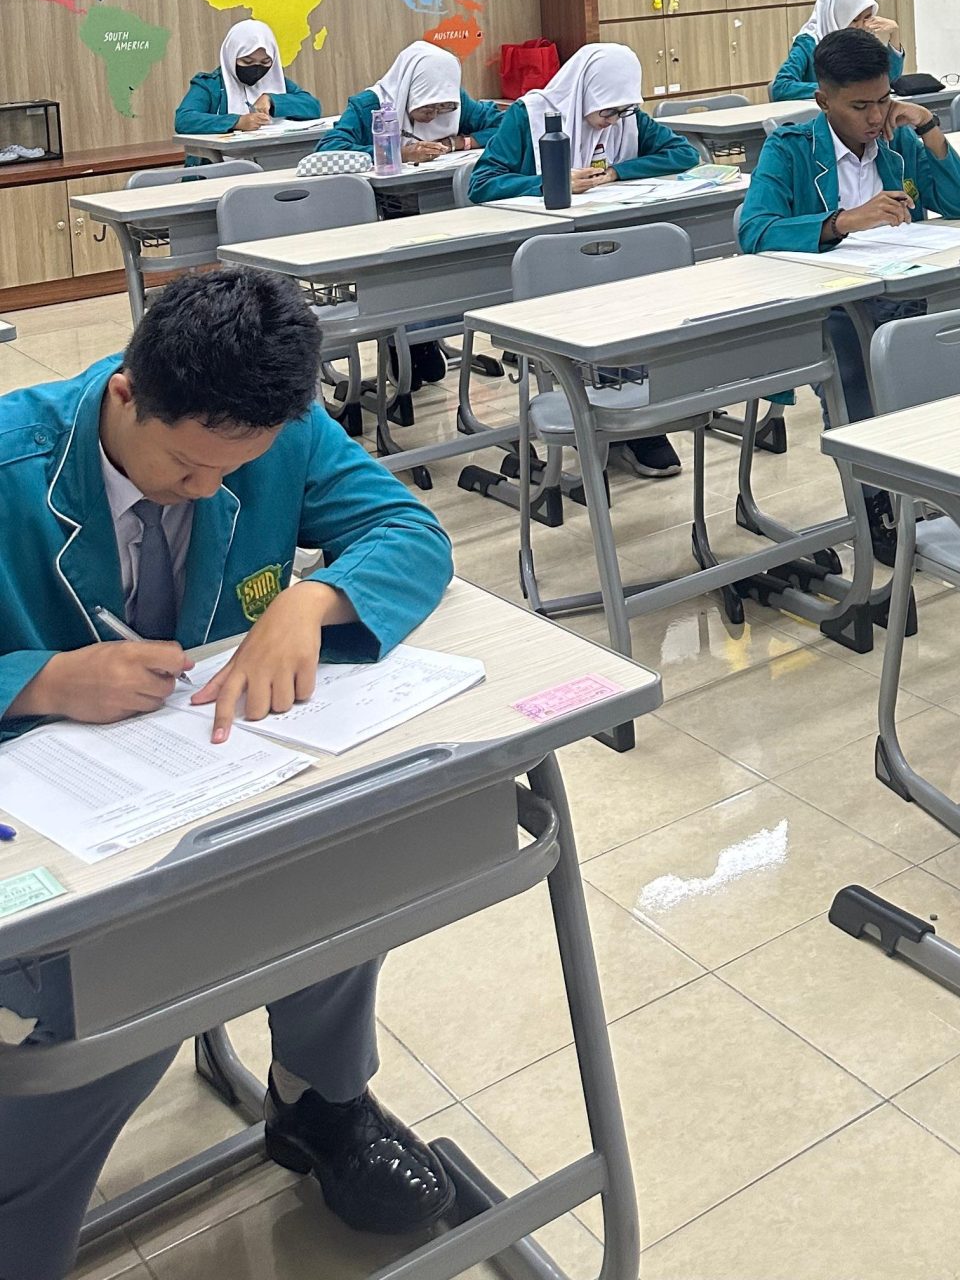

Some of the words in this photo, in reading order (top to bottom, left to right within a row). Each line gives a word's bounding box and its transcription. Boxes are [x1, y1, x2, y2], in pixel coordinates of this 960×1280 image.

[104, 31, 129, 42] SOUTH
[115, 40, 150, 52] AMERICA
[244, 571, 276, 605] SMA
